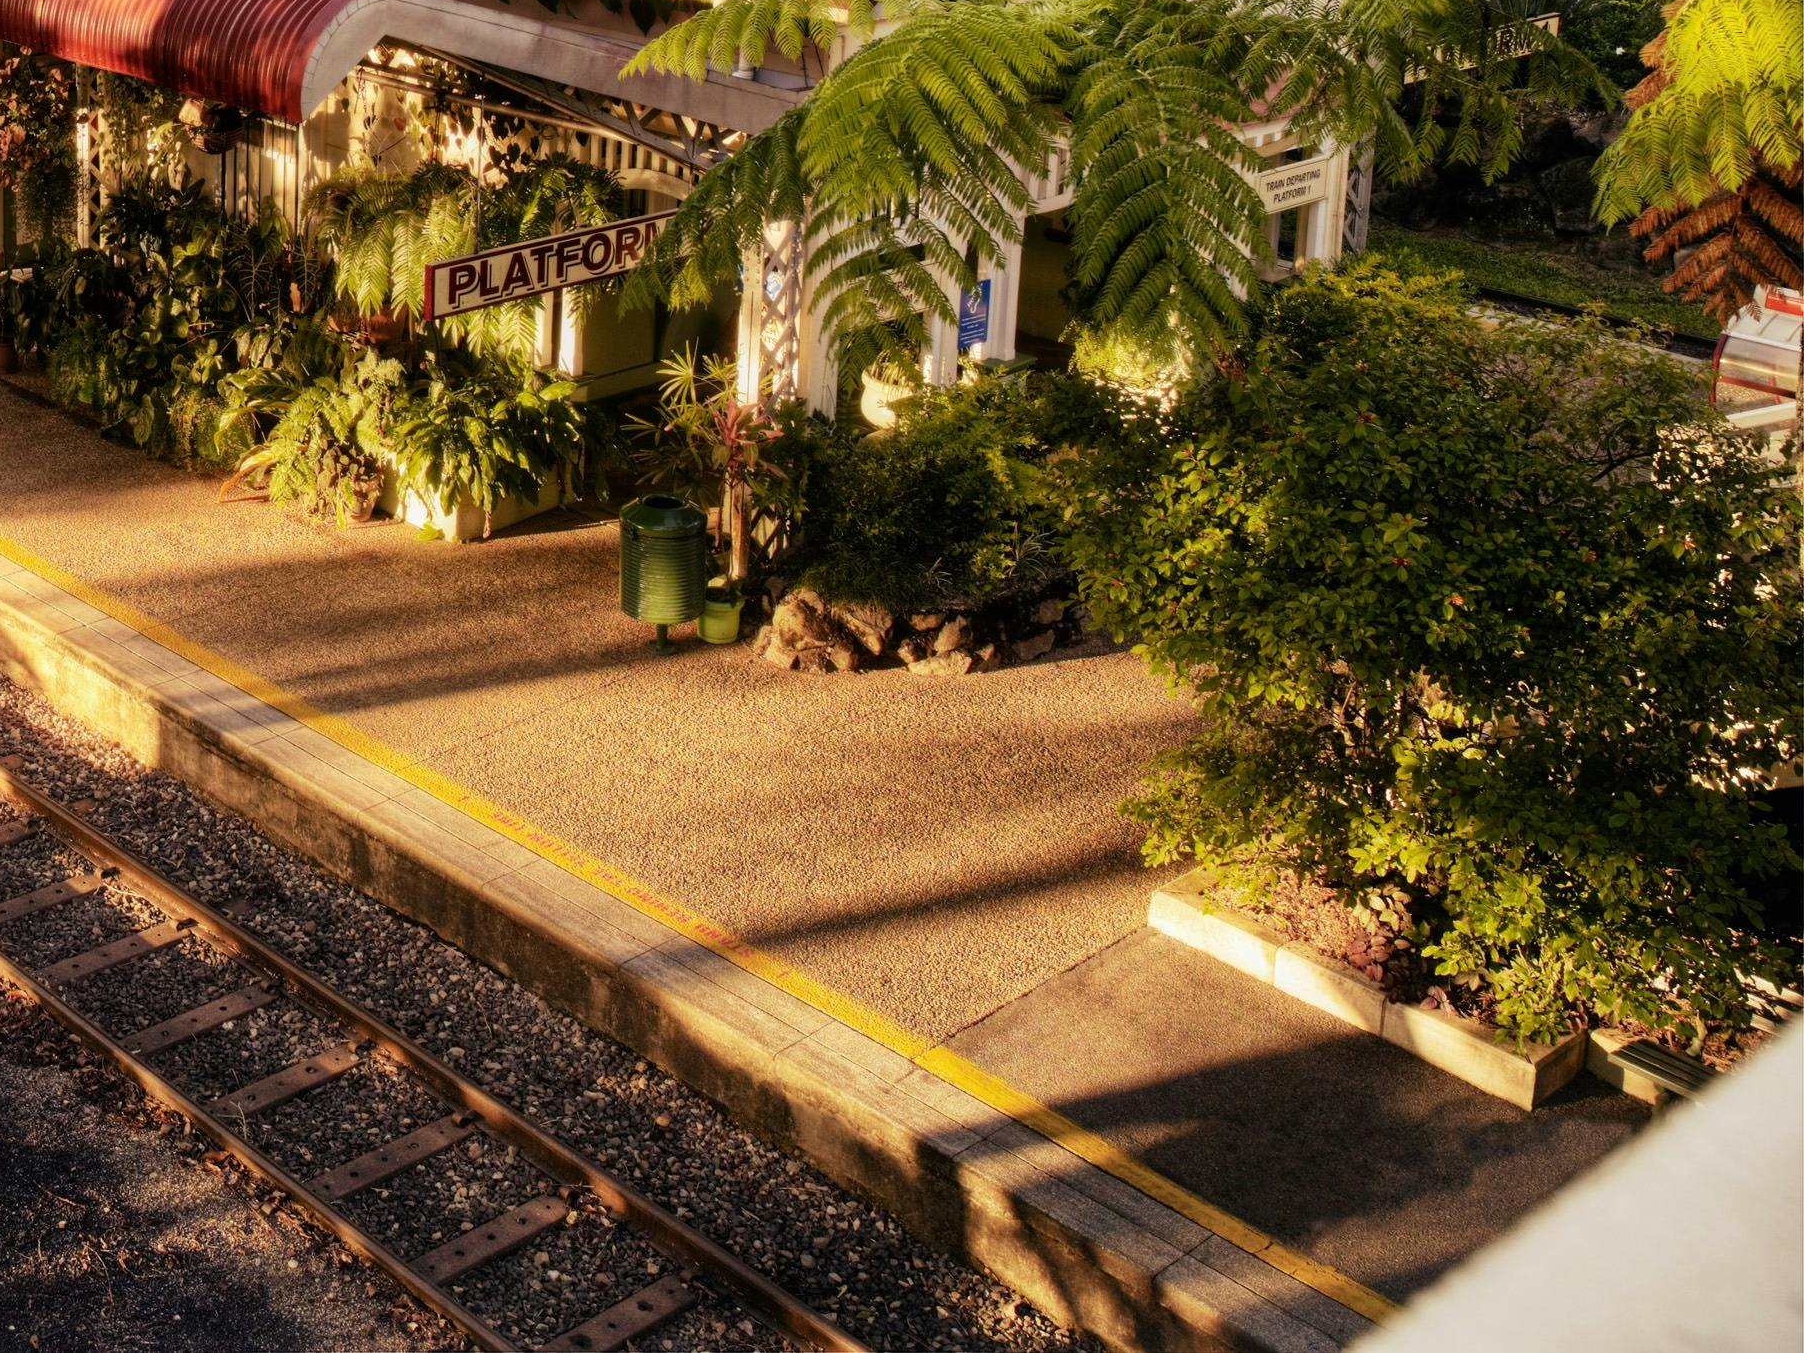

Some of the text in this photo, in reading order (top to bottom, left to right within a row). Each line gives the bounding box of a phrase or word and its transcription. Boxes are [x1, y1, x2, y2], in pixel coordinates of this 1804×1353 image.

[1266, 169, 1321, 192] TRAIN DEPARTING
[1273, 187, 1307, 204] PLATFORM
